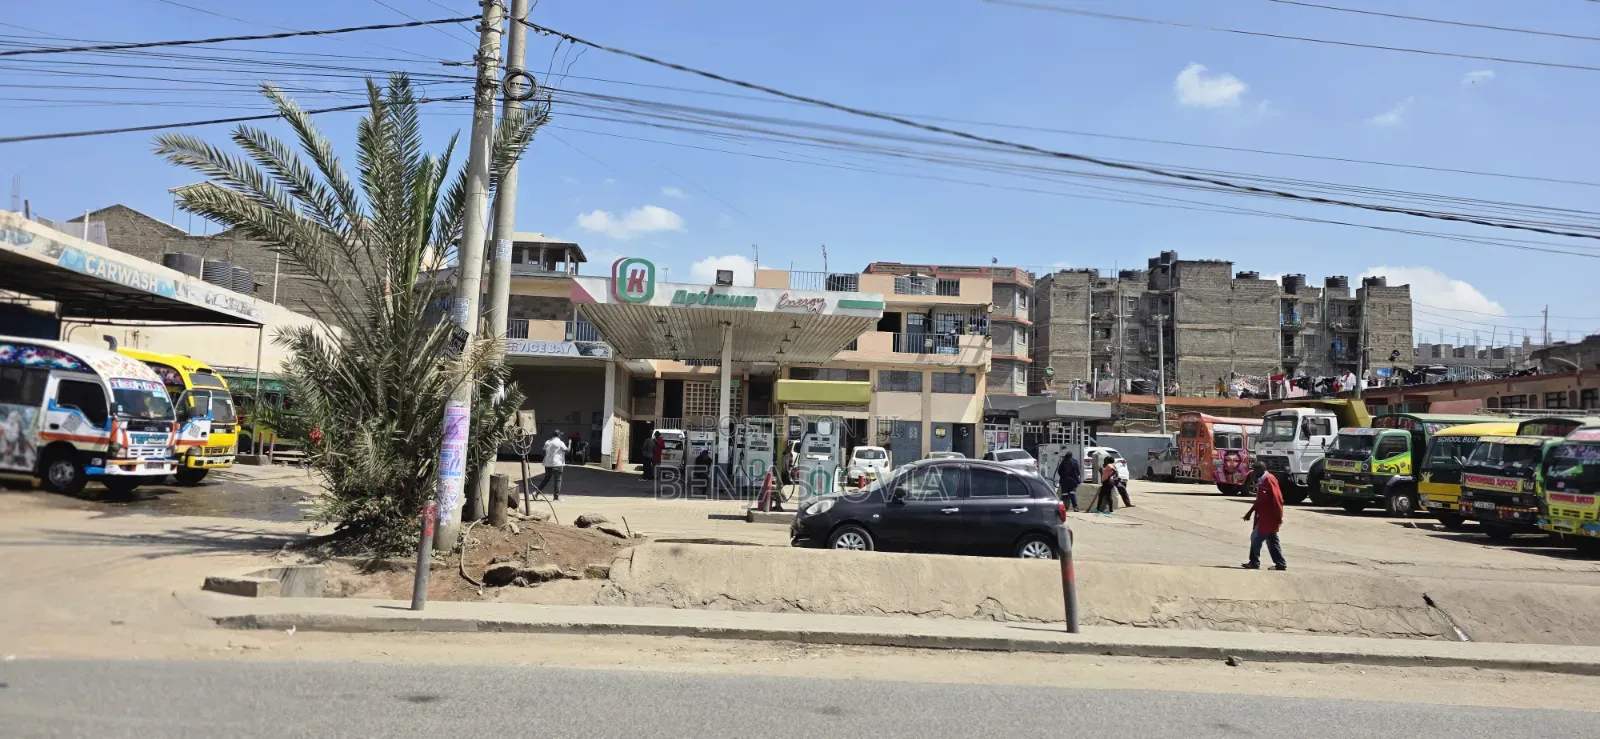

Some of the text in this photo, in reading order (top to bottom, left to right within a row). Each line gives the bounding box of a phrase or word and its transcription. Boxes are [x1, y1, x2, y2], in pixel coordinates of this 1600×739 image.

[85, 254, 159, 293] CARWASH
[626, 268, 646, 293] K
[672, 286, 827, 314] Optimum Energy
[547, 342, 572, 355] BAY
